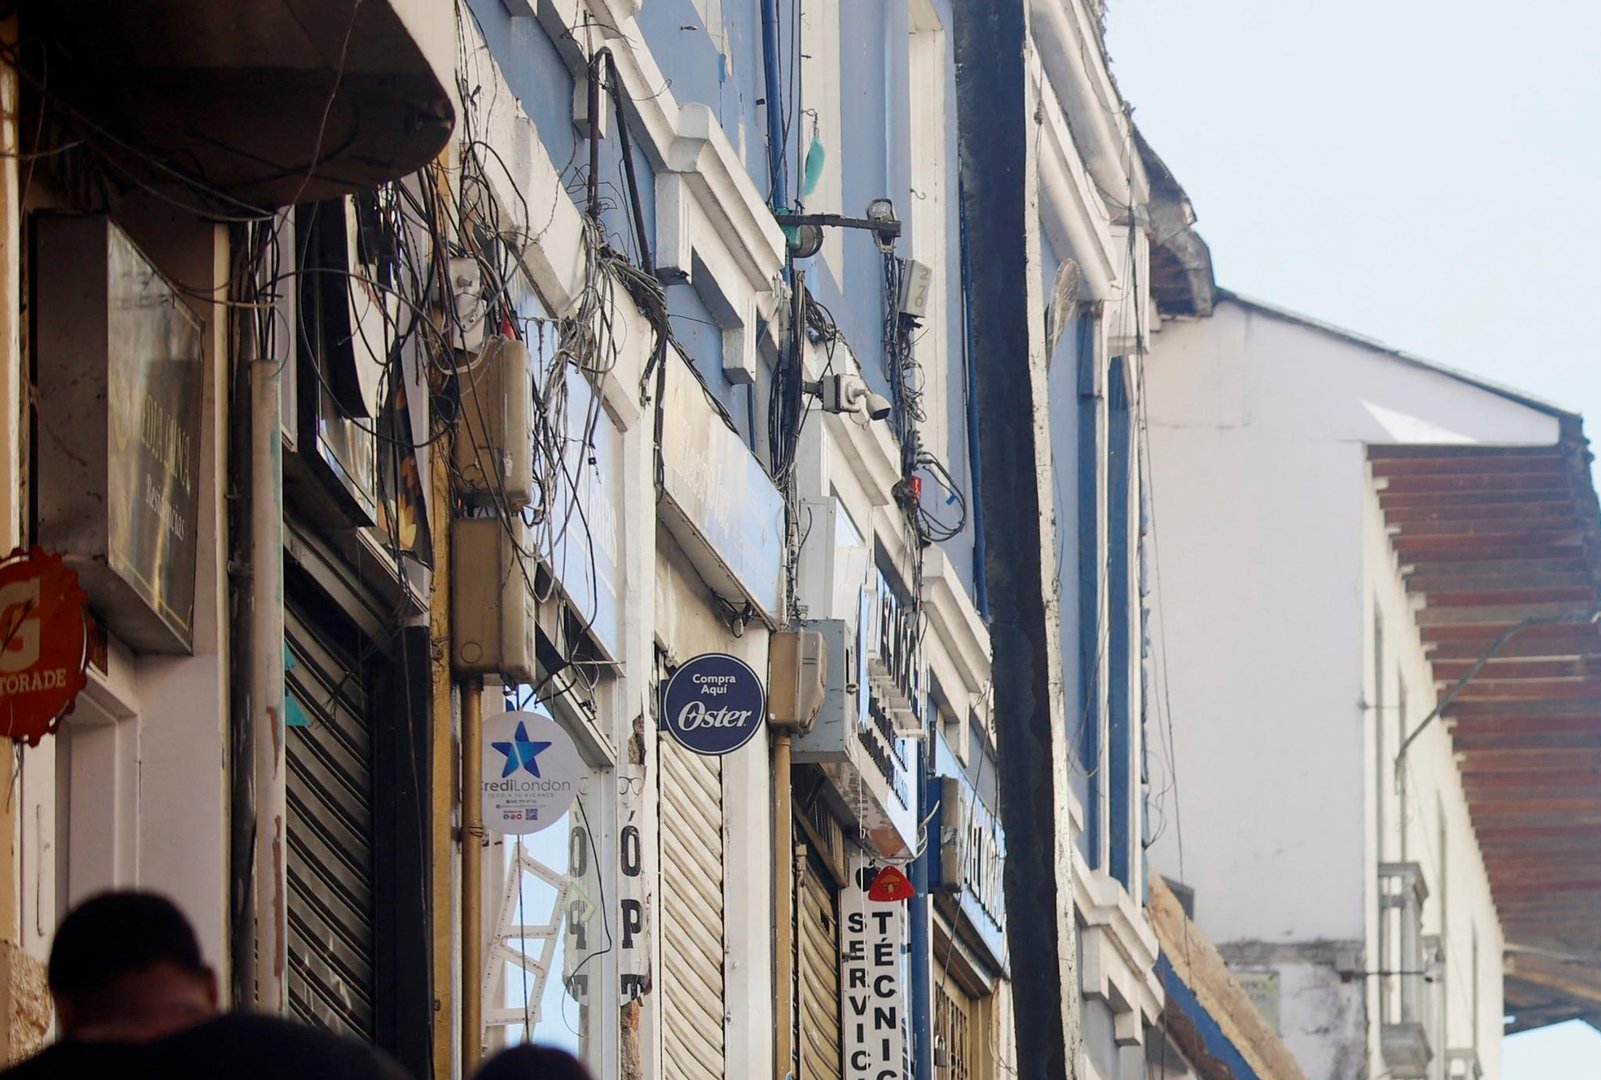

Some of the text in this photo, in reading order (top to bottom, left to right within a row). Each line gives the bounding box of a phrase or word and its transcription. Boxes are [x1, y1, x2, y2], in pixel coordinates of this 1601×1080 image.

[692, 673, 737, 686] Compra
[700, 684, 728, 697] Aquí
[678, 701, 753, 731] Oster
